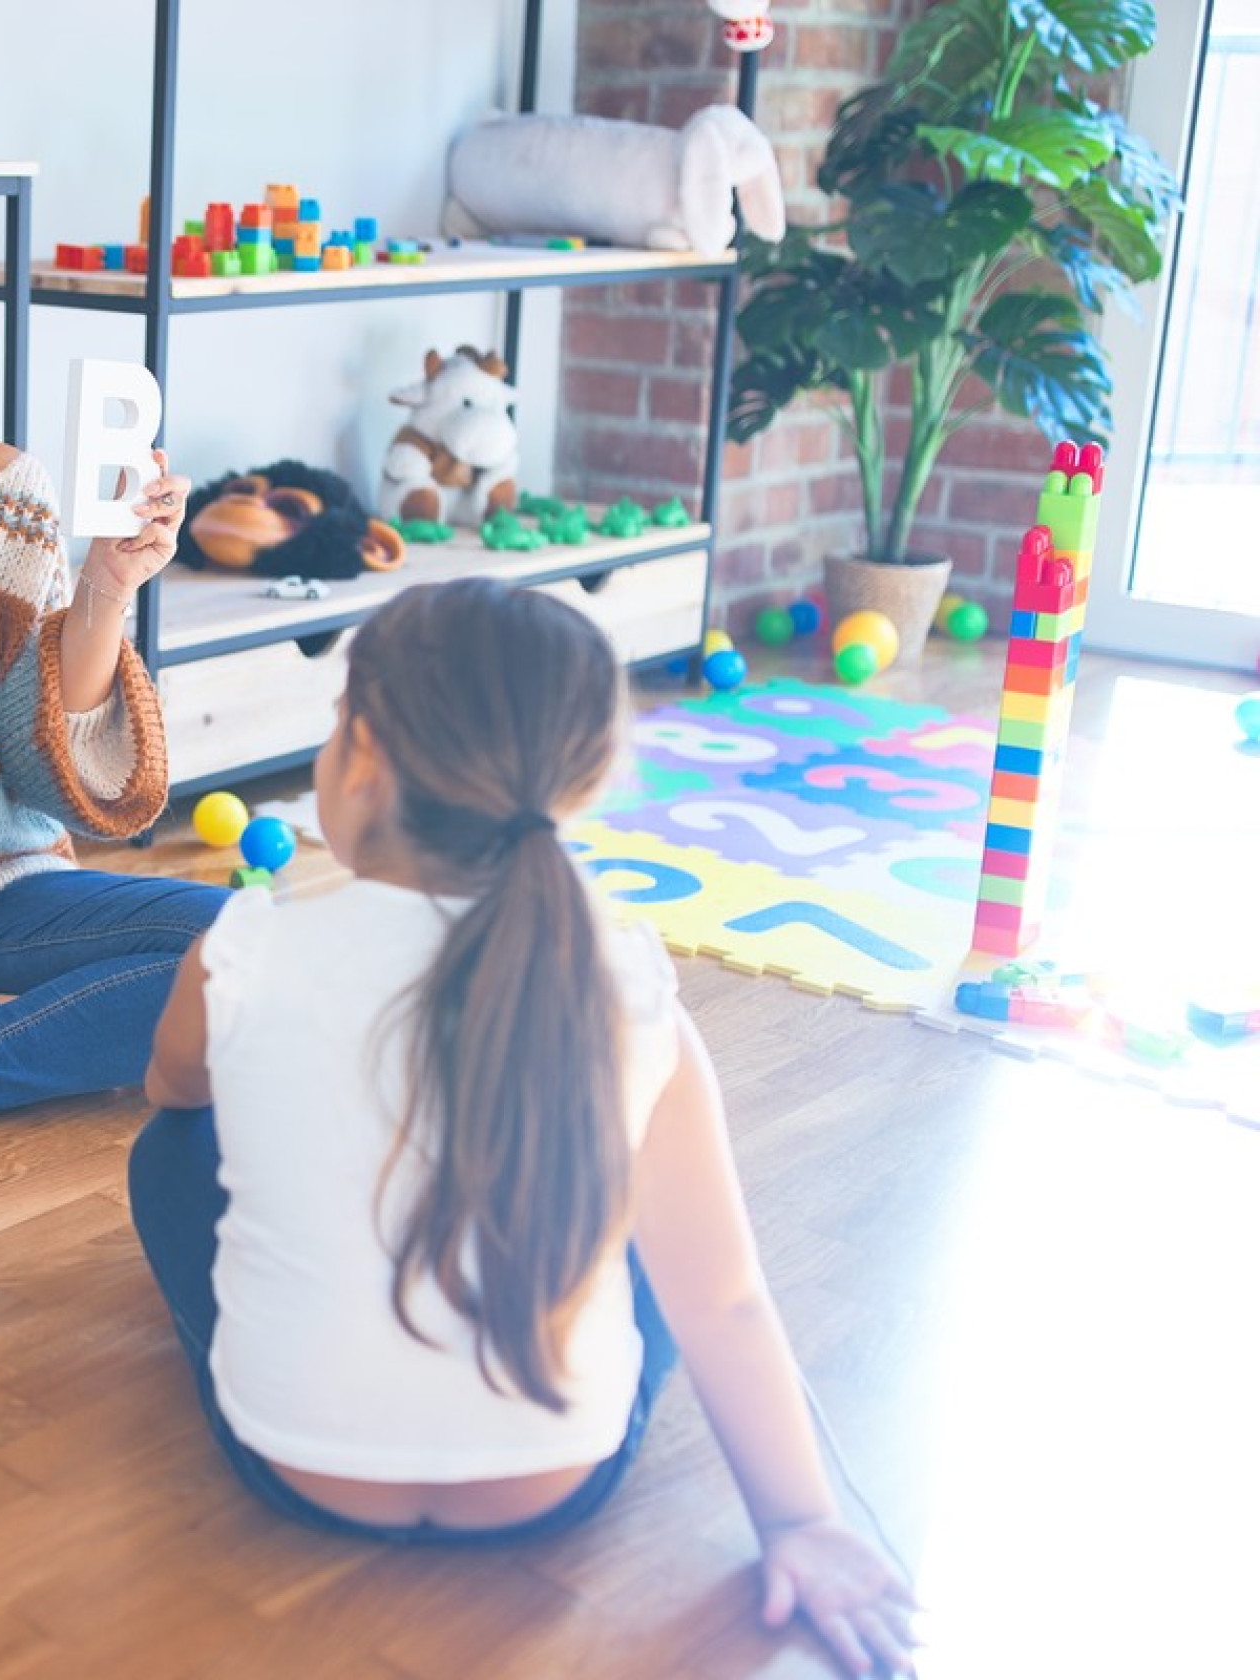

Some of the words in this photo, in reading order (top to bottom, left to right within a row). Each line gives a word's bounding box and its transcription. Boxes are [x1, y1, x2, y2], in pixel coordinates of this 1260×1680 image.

[64, 358, 162, 538] B
[633, 721, 778, 763] 8
[804, 765, 980, 811] 3
[669, 801, 867, 855] 2
[723, 901, 933, 971] 7
